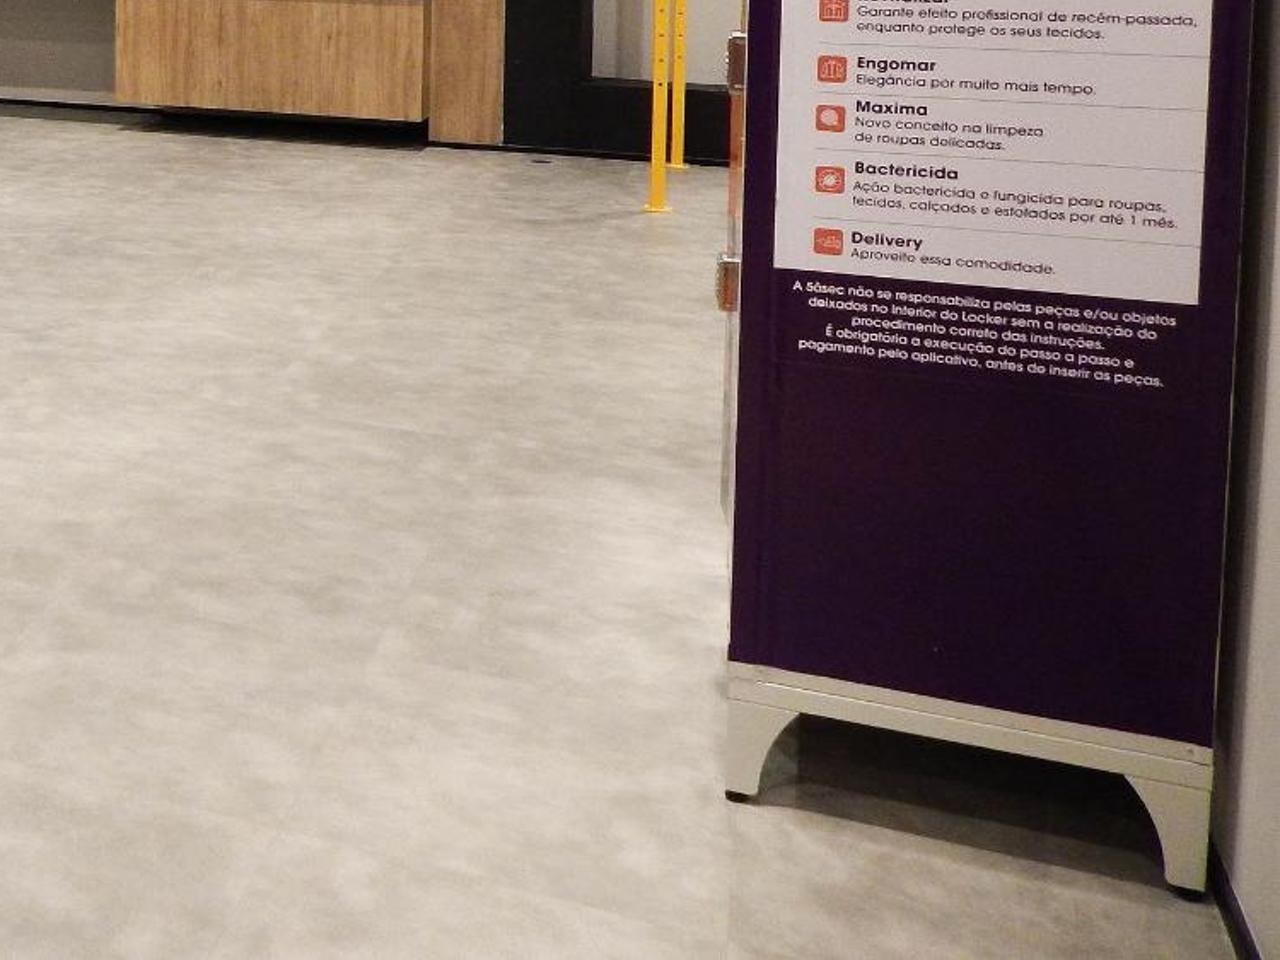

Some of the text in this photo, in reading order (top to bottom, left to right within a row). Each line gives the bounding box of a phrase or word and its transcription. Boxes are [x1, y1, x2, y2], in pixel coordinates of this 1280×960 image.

[857, 6, 913, 17] Garante
[918, 8, 958, 19] efeito
[962, 10, 1043, 22] profissional
[1048, 12, 1067, 22] de
[857, 22, 924, 33] enquanto
[928, 24, 985, 37] protege
[990, 27, 1006, 36] os
[1010, 27, 1042, 37] seus
[857, 57, 936, 73] Engomar
[931, 78, 954, 90] por
[959, 79, 999, 90] muito
[1005, 81, 1039, 92] mais
[856, 101, 928, 116] Maxima
[855, 117, 1044, 138] Novo conceito na limpeza
[855, 132, 1005, 150] de roupas delicadas.
[855, 161, 958, 179] Bactericida
[853, 181, 890, 194] Ação
[894, 183, 975, 200] bactericida
[980, 191, 989, 200] e
[993, 190, 1063, 205] fungicida
[1068, 197, 1104, 208] para
[909, 200, 977, 214] calçados
[981, 206, 990, 215] e
[994, 207, 1065, 221] estofados
[1070, 212, 1095, 223] por
[1099, 213, 1124, 225] até
[1131, 215, 1136, 225] 1
[1142, 216, 1178, 229] mês.
[851, 231, 923, 251] Delivery
[920, 255, 951, 266] essa
[956, 257, 1055, 275] comodidade.
[793, 280, 802, 291] A
[848, 286, 874, 298] não
[877, 290, 892, 299] se
[896, 291, 990, 309] responsabiliza
[993, 301, 1032, 312] pelas
[1035, 305, 1080, 318] peças
[1083, 308, 1118, 321] e/ou
[1122, 312, 1177, 327] objetos
[809, 297, 868, 311] deixados
[871, 303, 888, 313] no
[940, 309, 958, 321] do
[962, 311, 1007, 325] Locker
[1011, 318, 1040, 329] sem
[1044, 320, 1053, 330] a
[1058, 322, 1133, 339] realização
[1137, 328, 1157, 340] do
[851, 317, 1105, 351] procedimento correto das instruções.
[825, 323, 1134, 369] É obrigatória a execução do passo a passo e
[798, 339, 875, 356] pagamento
[878, 348, 908, 361] pelo
[986, 359, 1023, 371] antes
[1049, 364, 1090, 379] inserir
[1094, 369, 1111, 381] as
[1114, 372, 1164, 387] peças.
